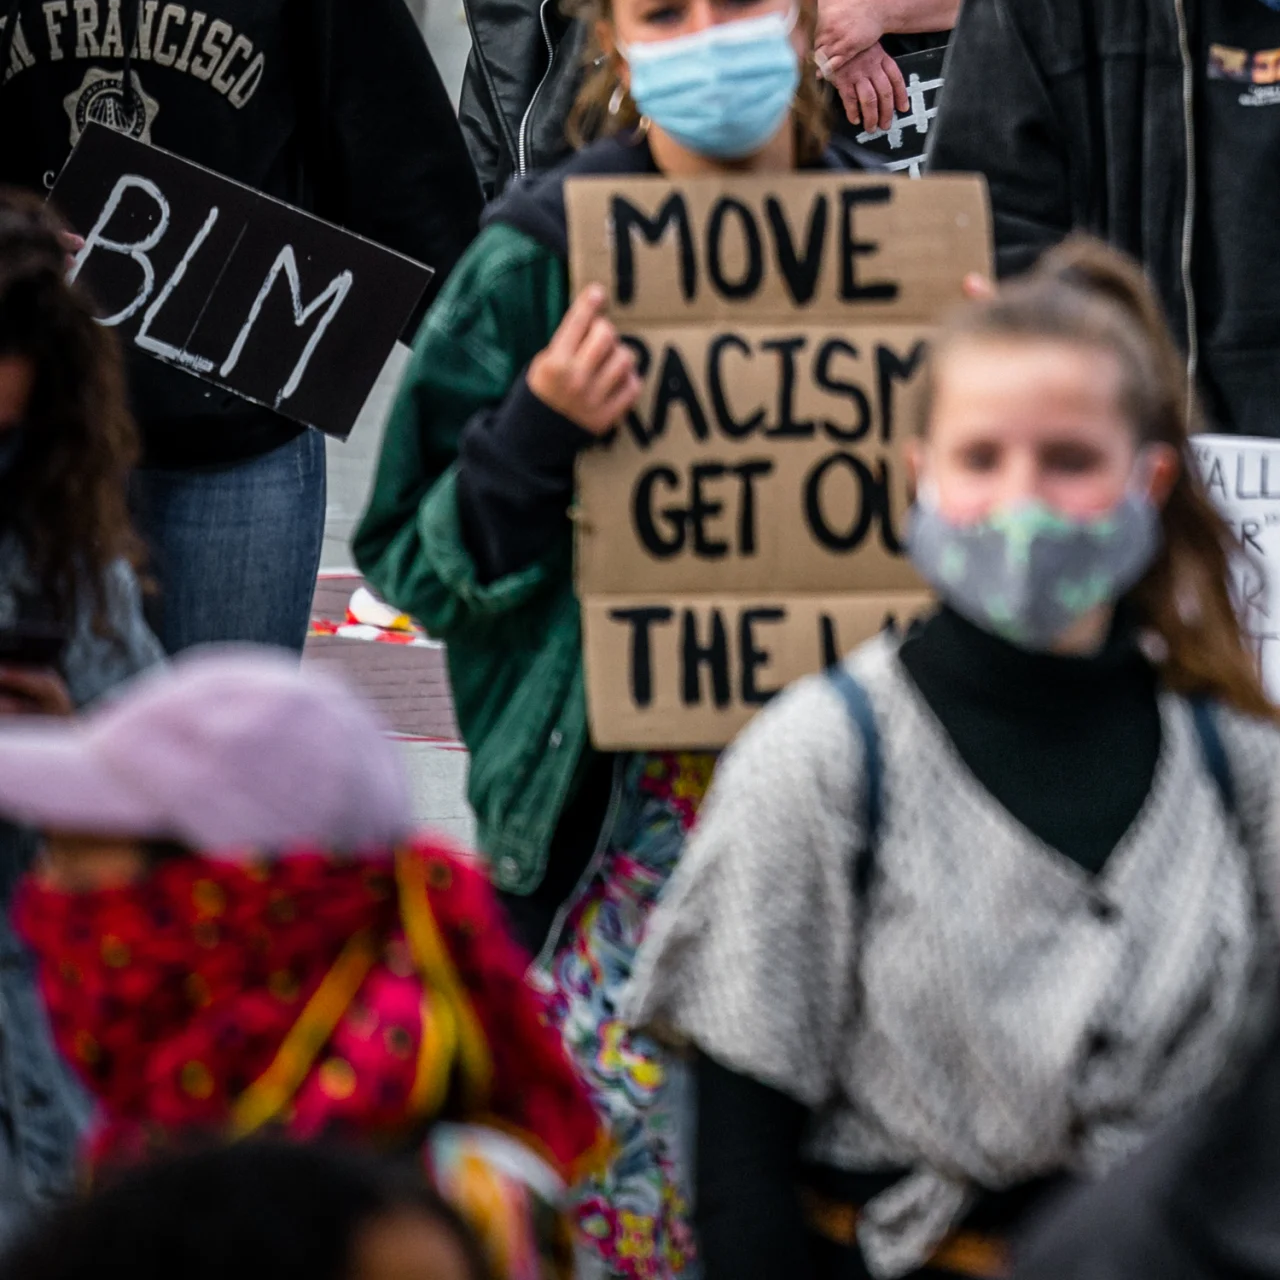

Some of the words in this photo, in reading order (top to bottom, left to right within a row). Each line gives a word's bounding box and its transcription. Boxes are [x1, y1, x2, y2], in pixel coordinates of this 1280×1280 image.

[67, 174, 353, 404] BLM
[610, 185, 898, 306] MOVE
[631, 460, 774, 559] GET
[803, 451, 912, 559] OU
[609, 605, 788, 708] THE
